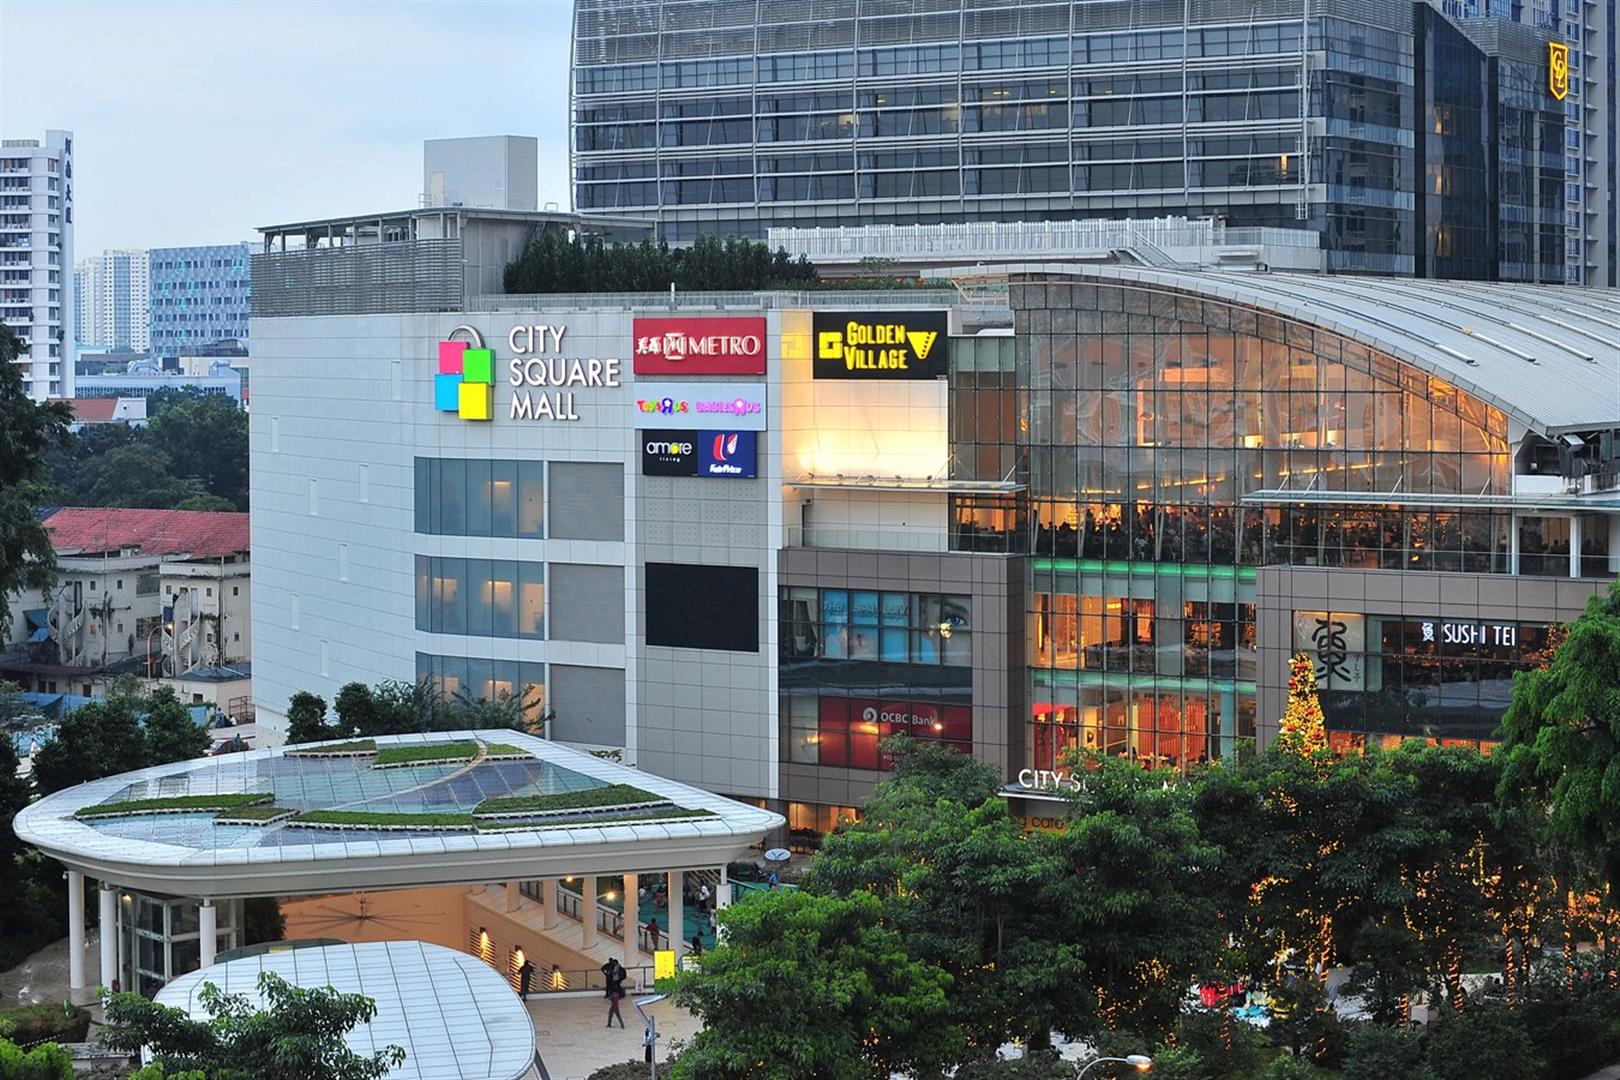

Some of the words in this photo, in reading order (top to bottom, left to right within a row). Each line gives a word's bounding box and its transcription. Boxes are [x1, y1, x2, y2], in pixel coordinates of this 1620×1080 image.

[508, 325, 567, 354] CITY
[846, 321, 906, 345] GOLDEN
[688, 335, 761, 356] METRO
[843, 346, 909, 370] VILLAGE
[508, 358, 621, 388] SQUARE
[509, 392, 580, 421] MALL
[646, 441, 692, 455] amore
[1444, 623, 1486, 644] SUSHI
[1492, 625, 1515, 647] TEI
[880, 712, 908, 724] OCBC
[911, 714, 936, 726] Bank
[1018, 768, 1063, 790] CITY
